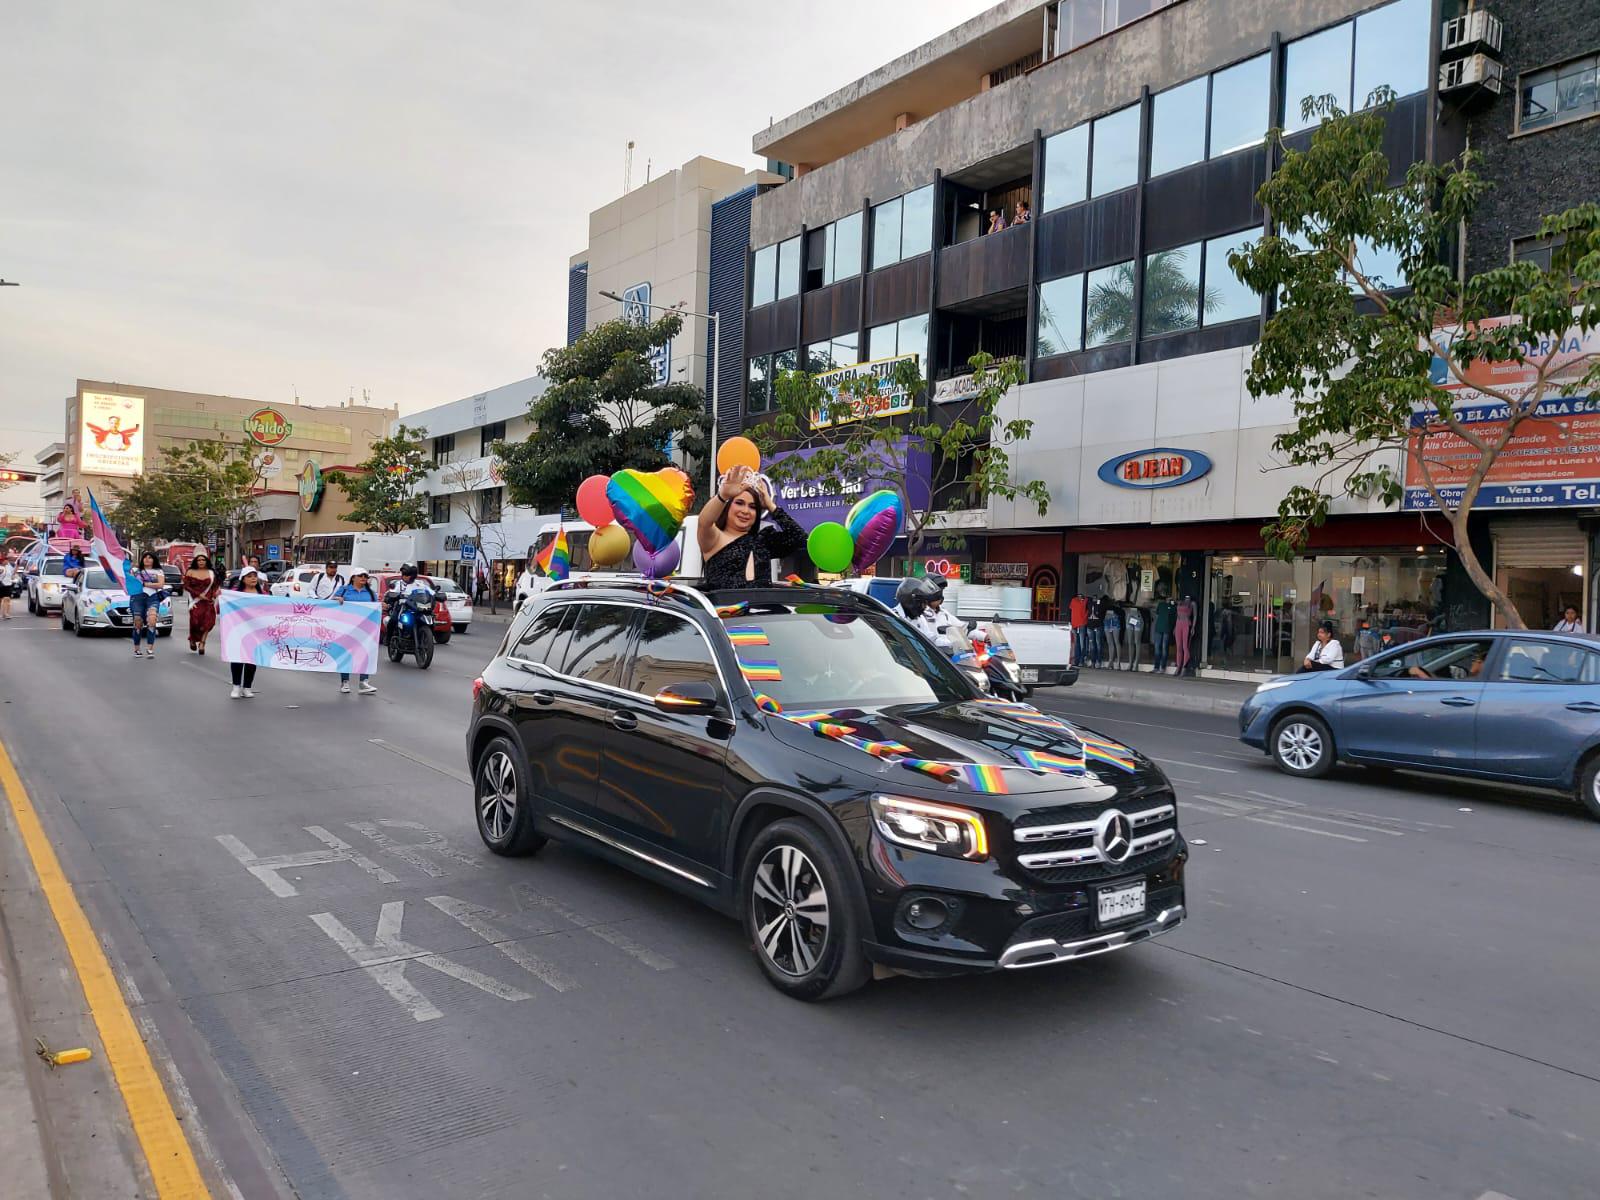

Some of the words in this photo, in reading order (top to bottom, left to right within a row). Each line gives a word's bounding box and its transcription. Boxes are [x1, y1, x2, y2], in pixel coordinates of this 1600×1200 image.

[1467, 410, 1484, 421] EL
[1527, 402, 1569, 416] ARA
[244, 418, 292, 436] Waldo's
[1424, 441, 1440, 450] Alta
[1560, 456, 1585, 464] Lunes
[781, 486, 799, 499] Ver
[1507, 486, 1532, 495] Ven
